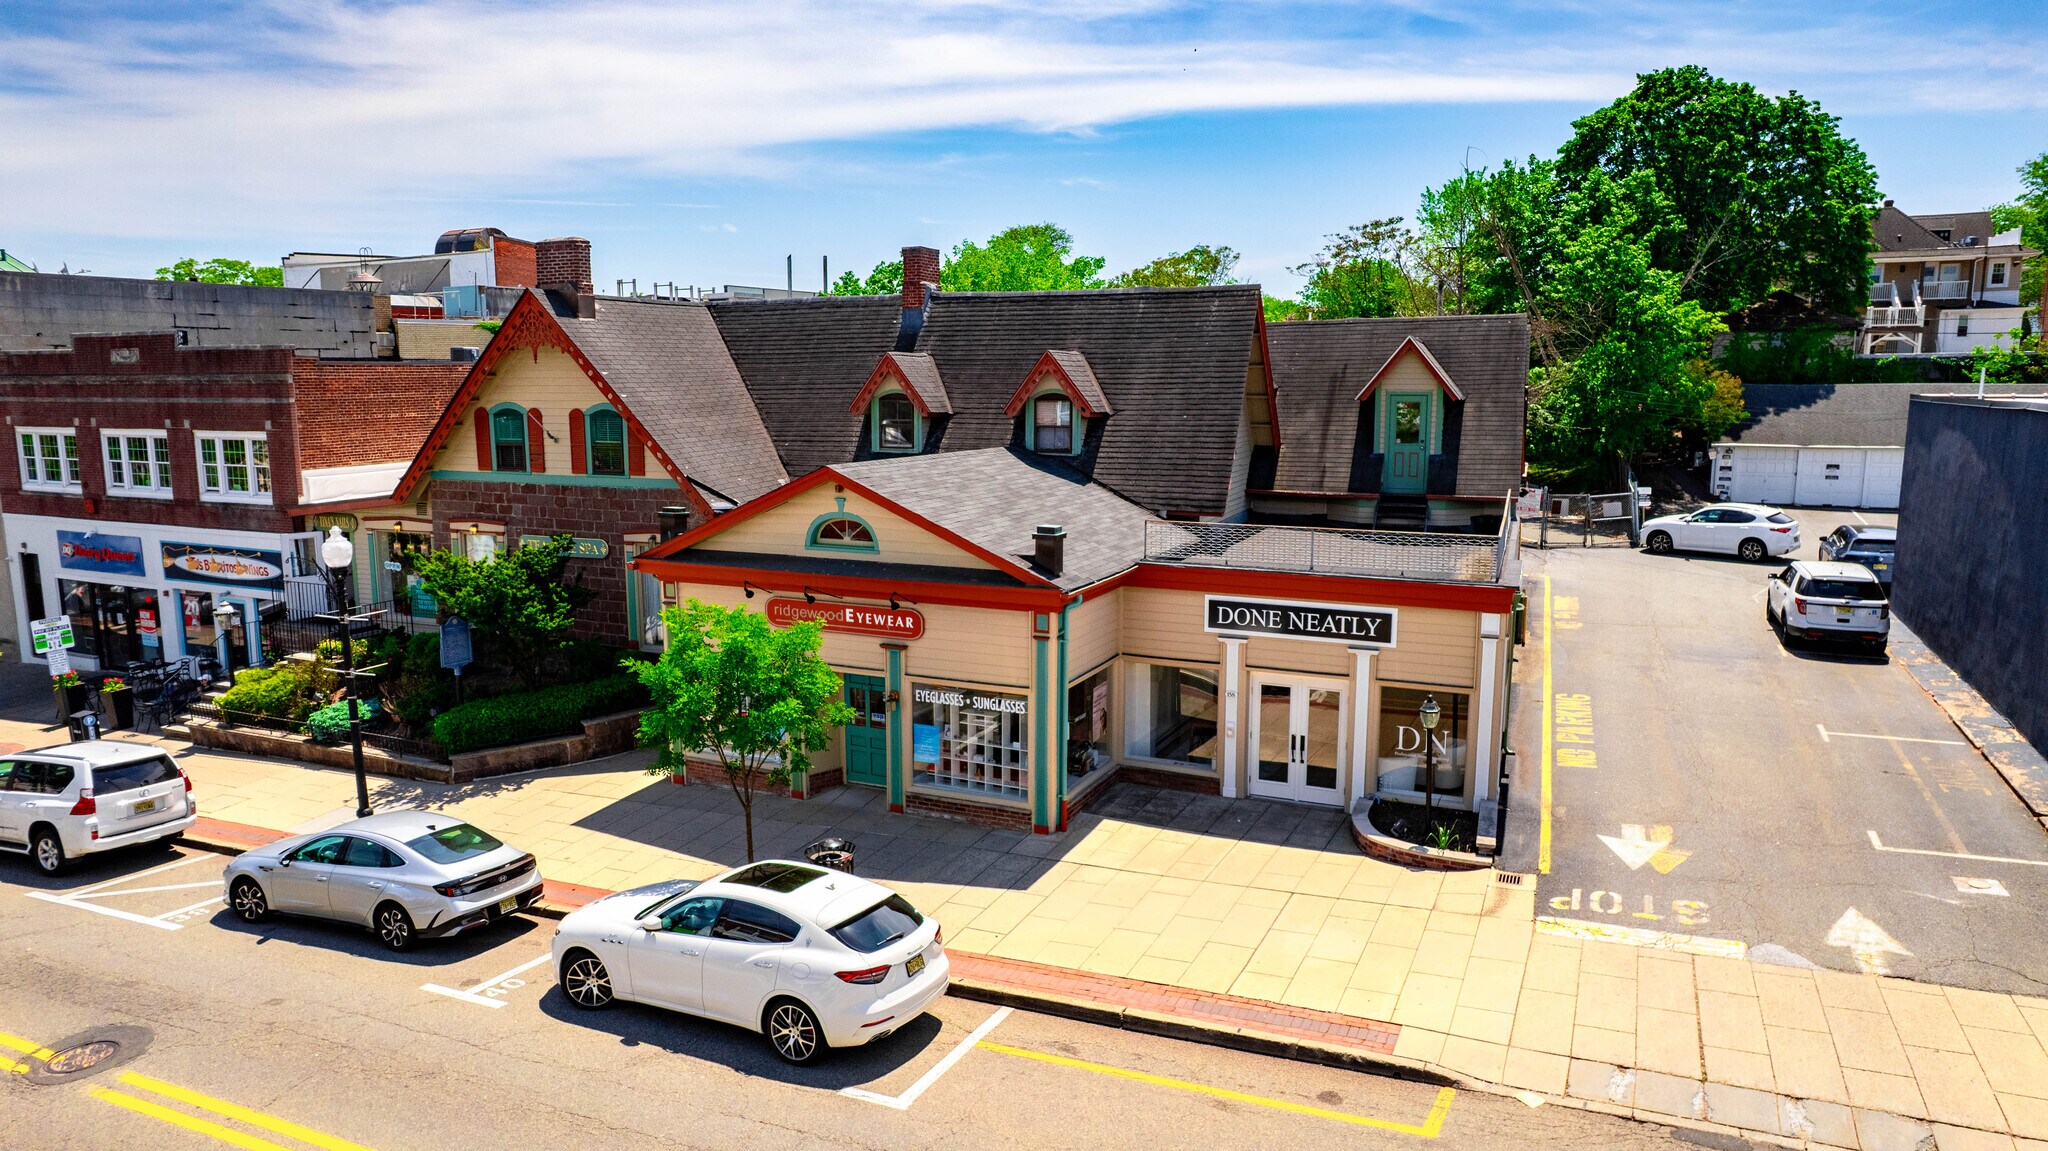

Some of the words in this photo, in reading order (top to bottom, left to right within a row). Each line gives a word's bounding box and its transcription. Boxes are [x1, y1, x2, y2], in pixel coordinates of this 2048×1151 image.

[74, 544, 102, 562] Dairy
[102, 547, 135, 562] Queen
[579, 542, 599, 555] SPA
[385, 562, 400, 570] OPEN
[184, 599, 200, 616] 20
[1217, 606, 1282, 629] DONE
[1288, 611, 1382, 637] NEATLY
[915, 689, 964, 707] EYEGLASSES
[972, 697, 1026, 714] SUNGLASSES
[1395, 725, 1450, 756] DN
